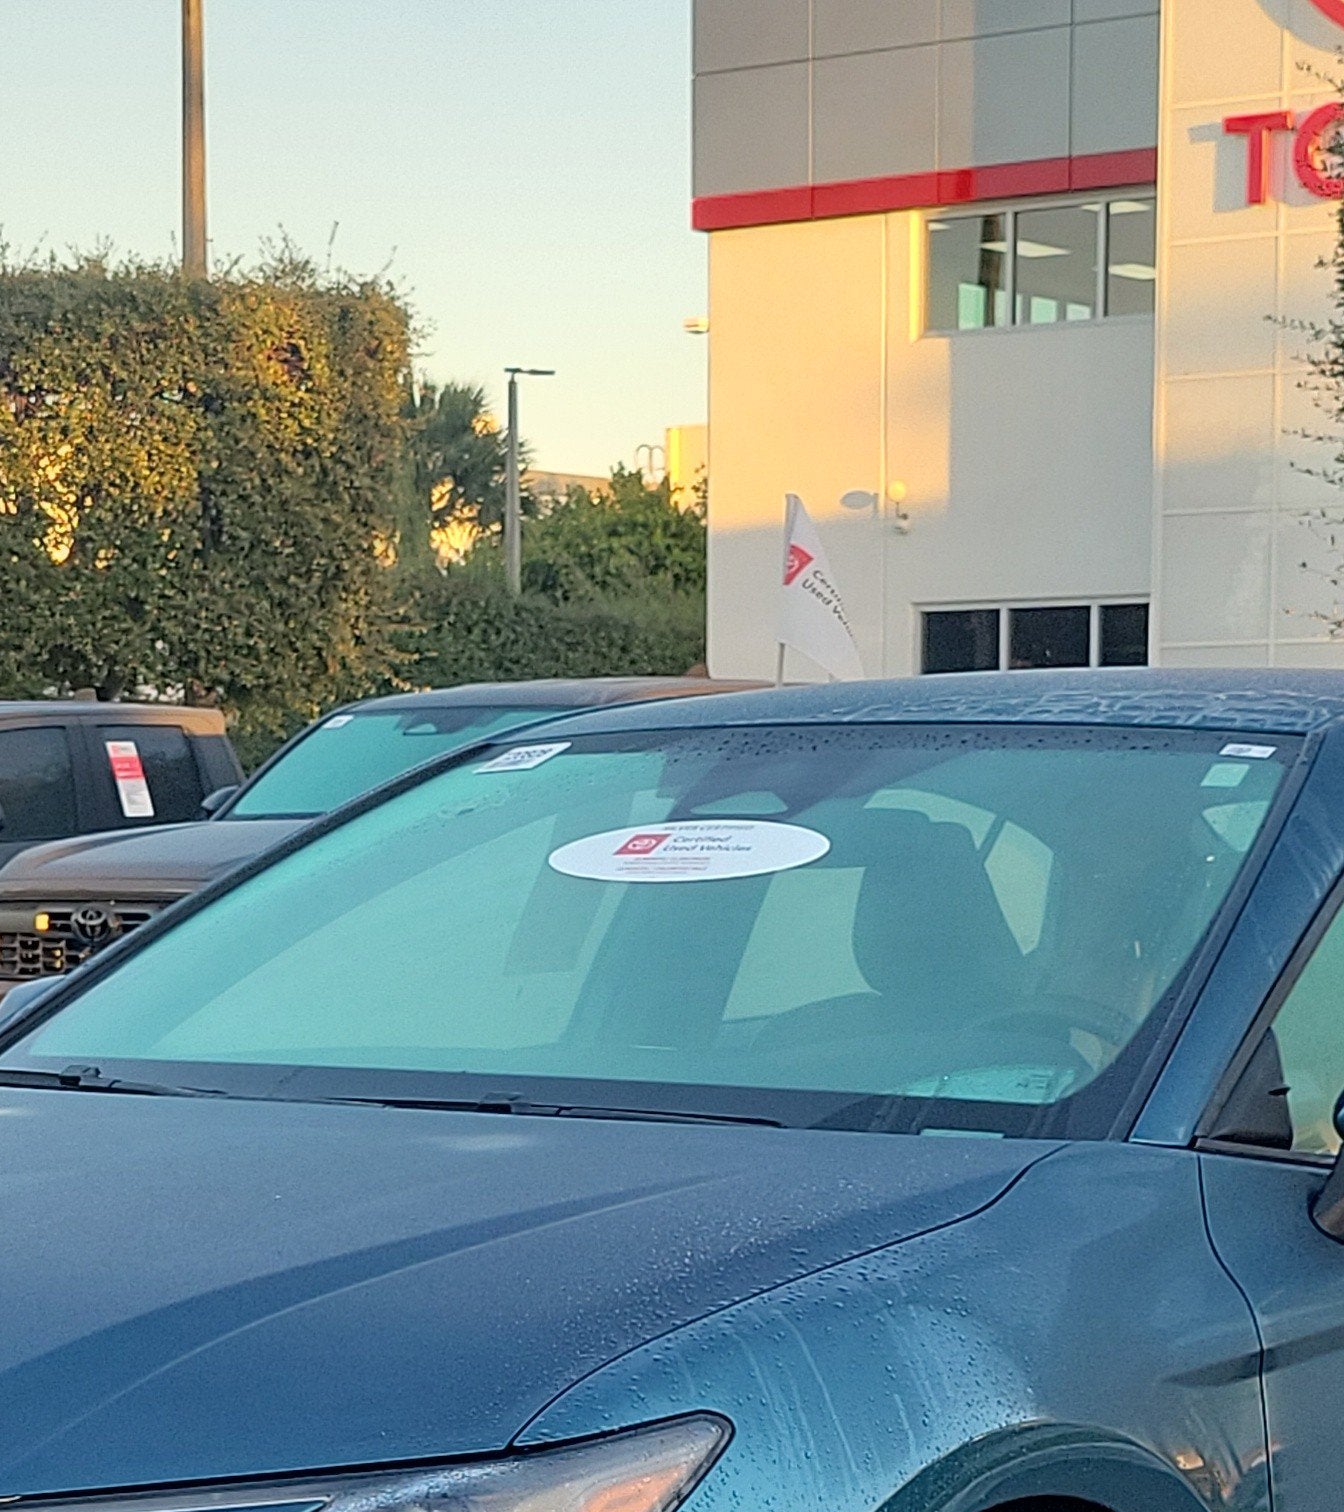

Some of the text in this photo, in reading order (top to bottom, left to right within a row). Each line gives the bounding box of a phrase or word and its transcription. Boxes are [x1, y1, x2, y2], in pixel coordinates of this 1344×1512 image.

[802, 578, 833, 606] Used
[673, 835, 733, 843] Certified
[662, 844, 752, 852] Used Vehicles
